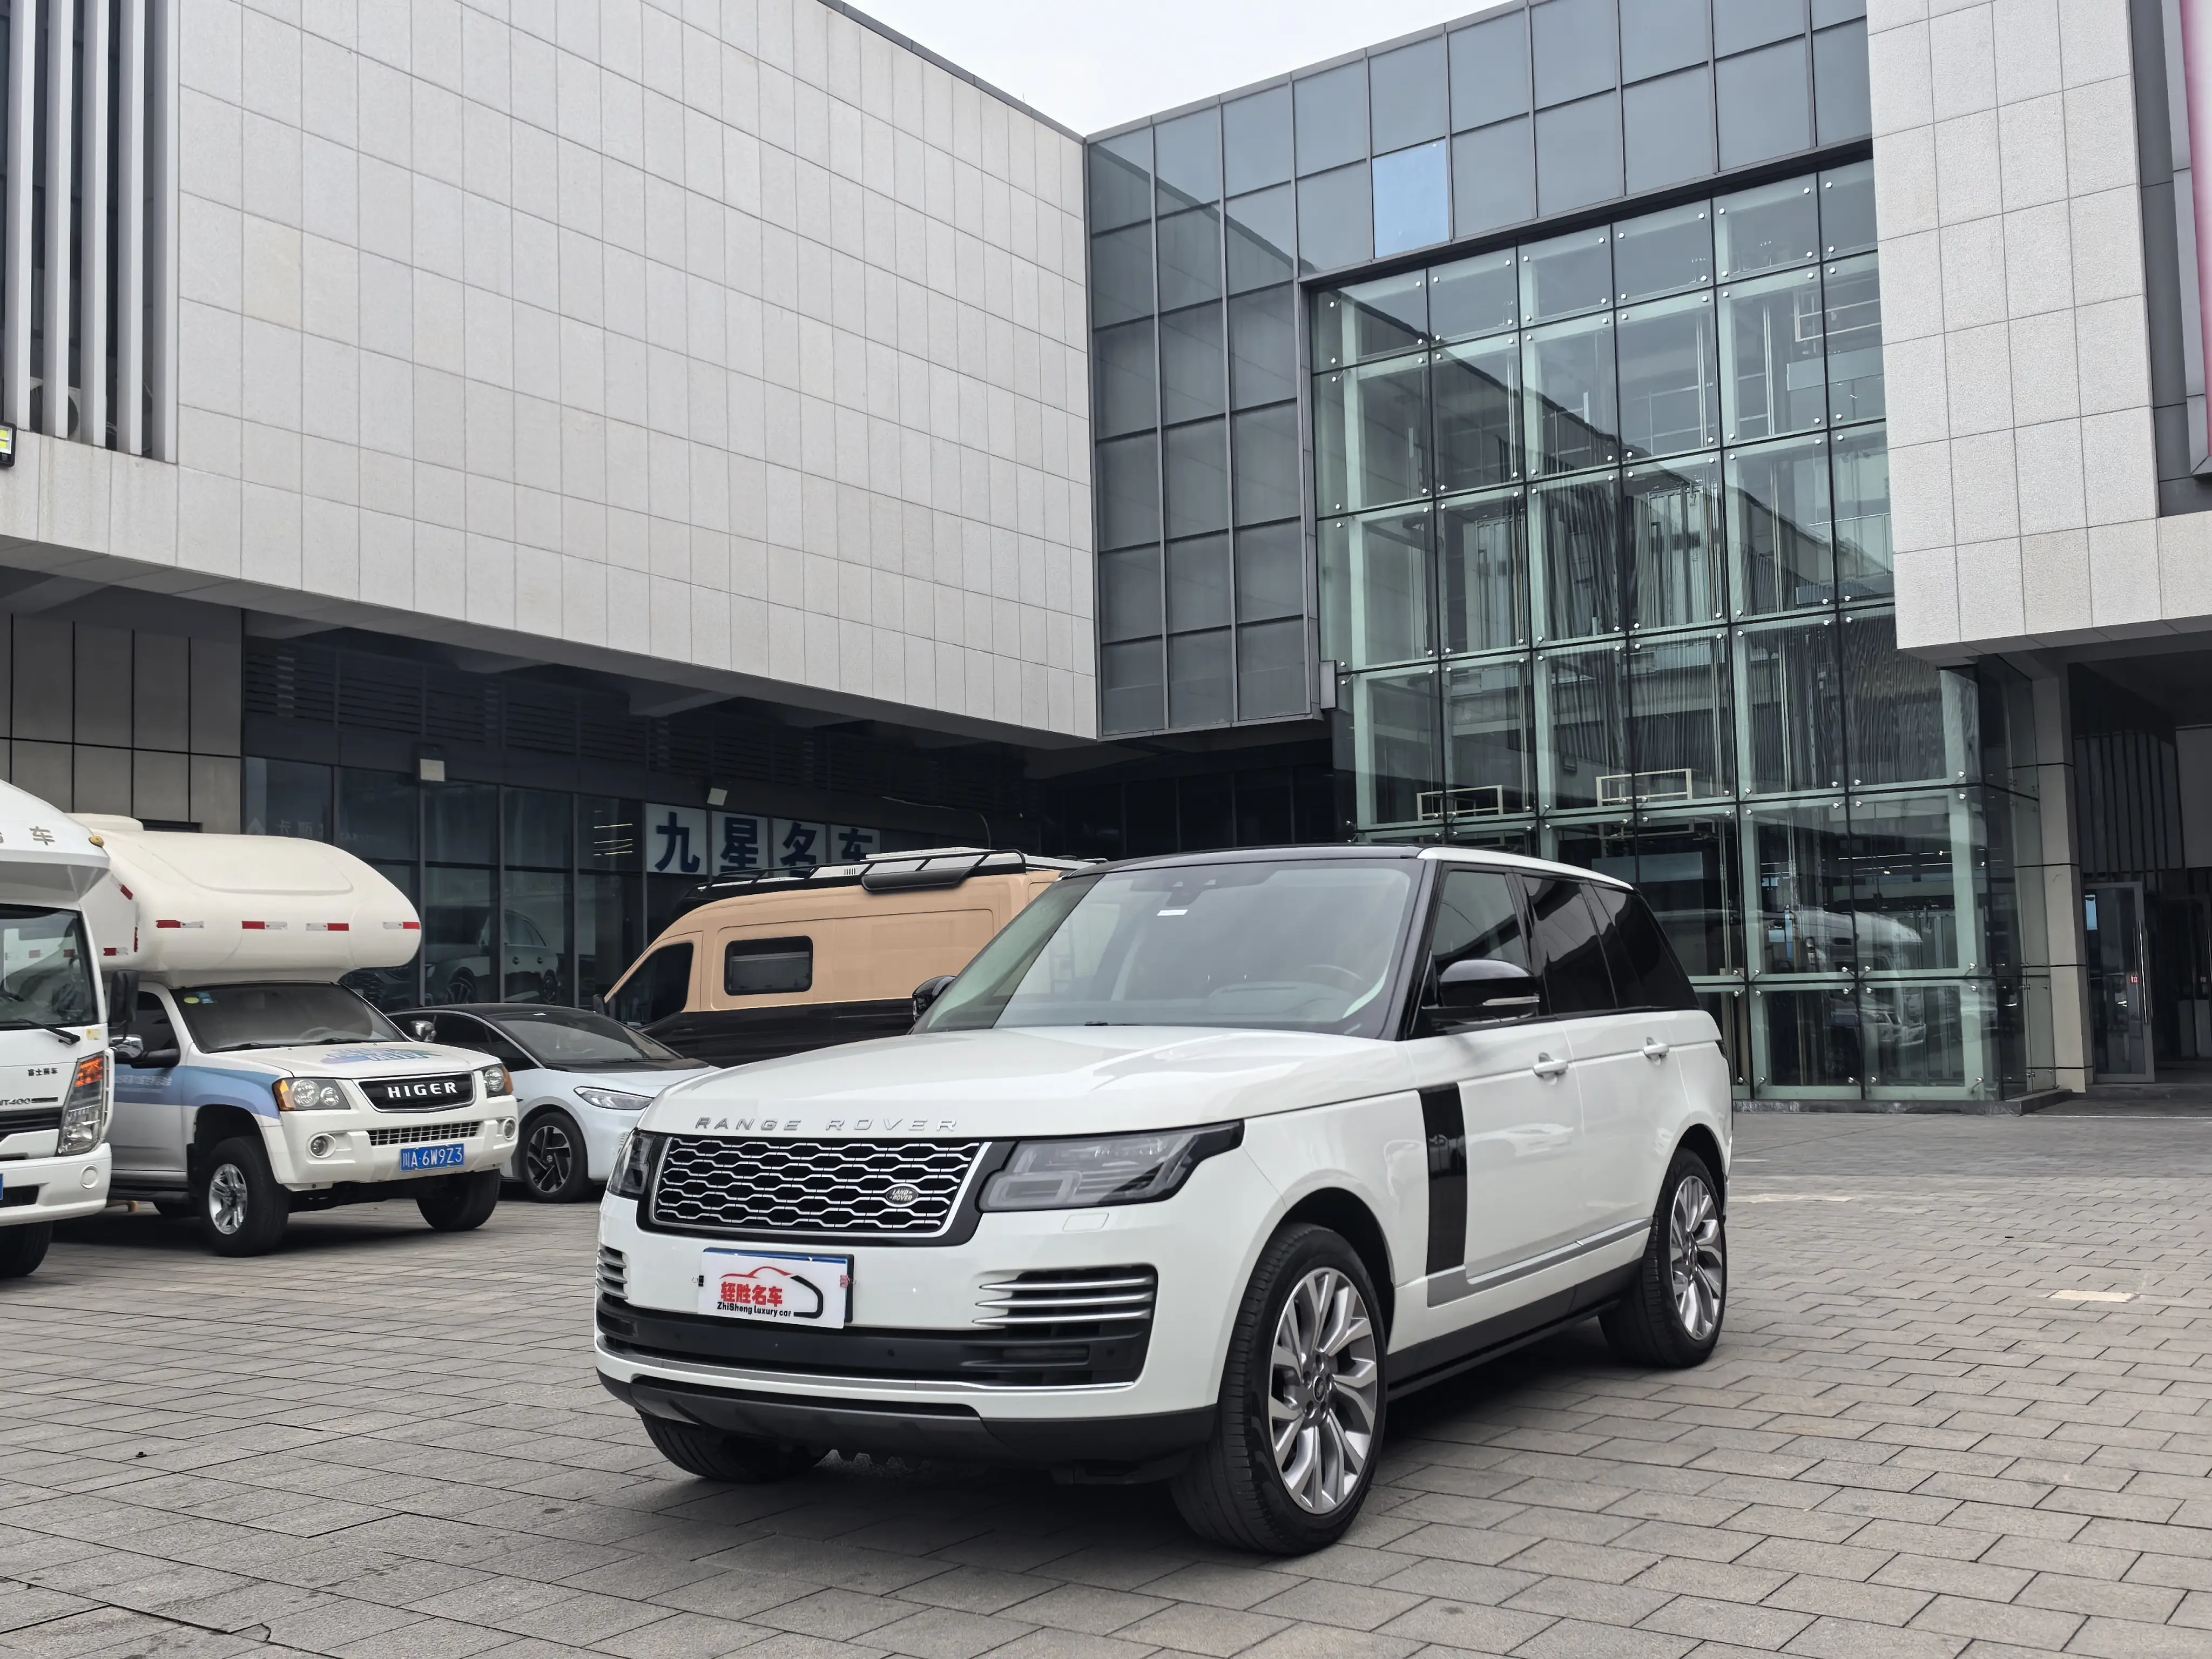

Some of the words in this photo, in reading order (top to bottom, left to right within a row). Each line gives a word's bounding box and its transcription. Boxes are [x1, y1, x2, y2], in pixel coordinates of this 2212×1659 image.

[655, 811, 874, 878] 九星名车
[387, 1082, 457, 1098] HIGER
[695, 1117, 801, 1130] RANGE
[826, 1118, 957, 1131] ROVER
